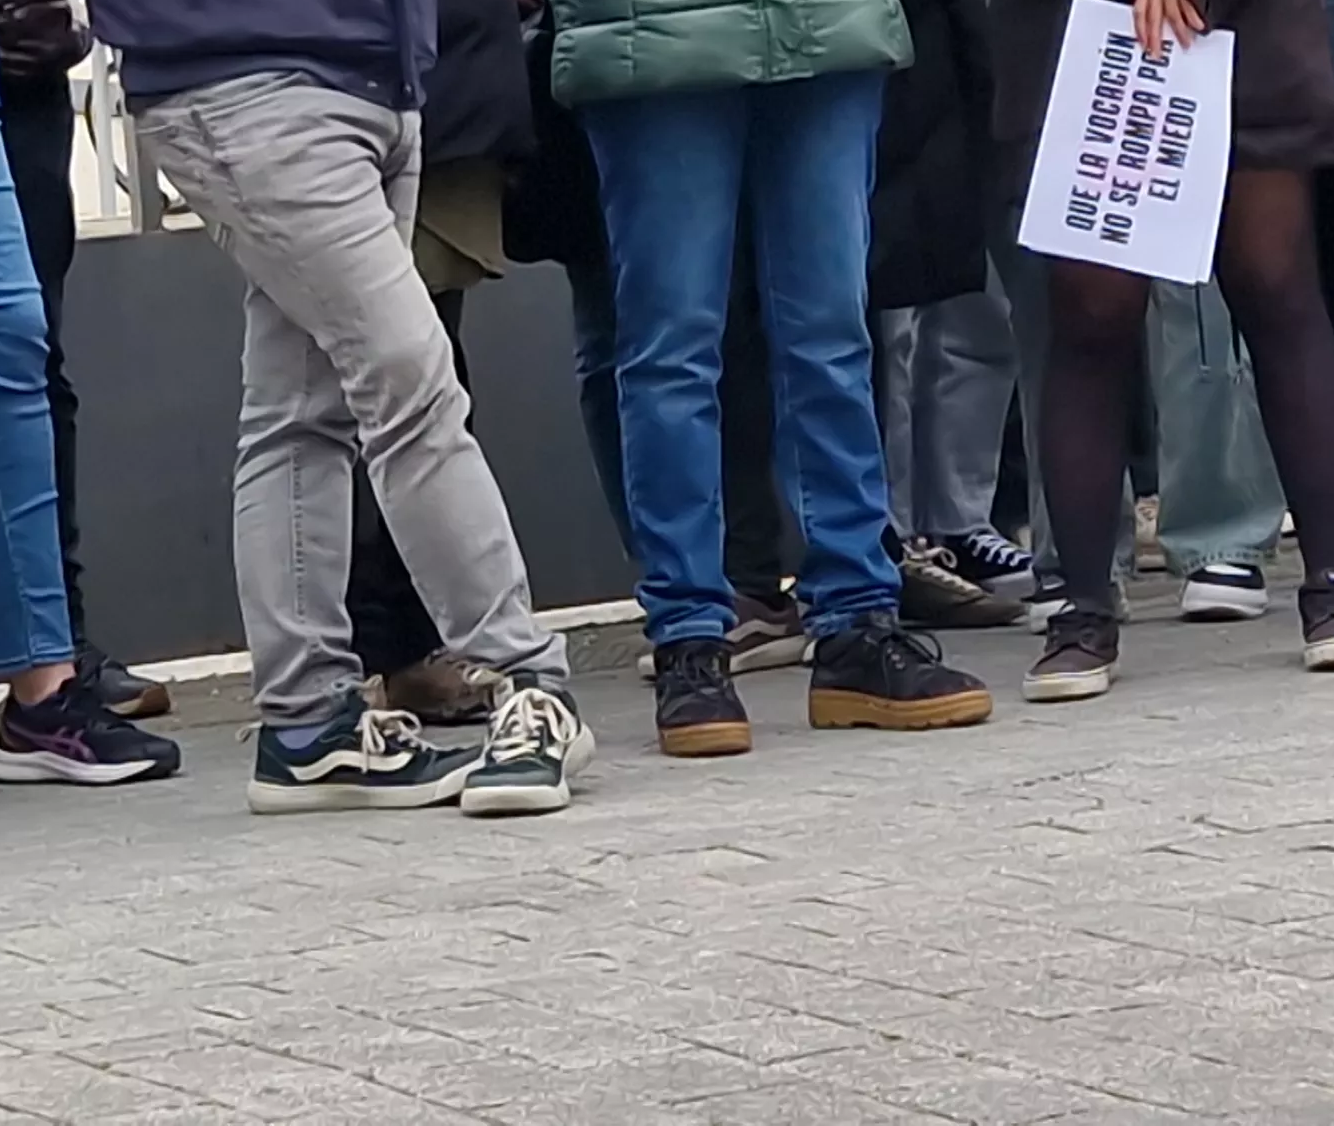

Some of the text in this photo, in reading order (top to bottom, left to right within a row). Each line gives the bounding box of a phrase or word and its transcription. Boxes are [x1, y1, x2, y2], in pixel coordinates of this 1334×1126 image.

[1065, 31, 1137, 232] QUE LA VOCACIÓN
[1116, 89, 1163, 172] ROMPA
[1148, 96, 1198, 202] EL MIEDO
[1099, 212, 1134, 245] NO
[1108, 178, 1142, 208] SE
